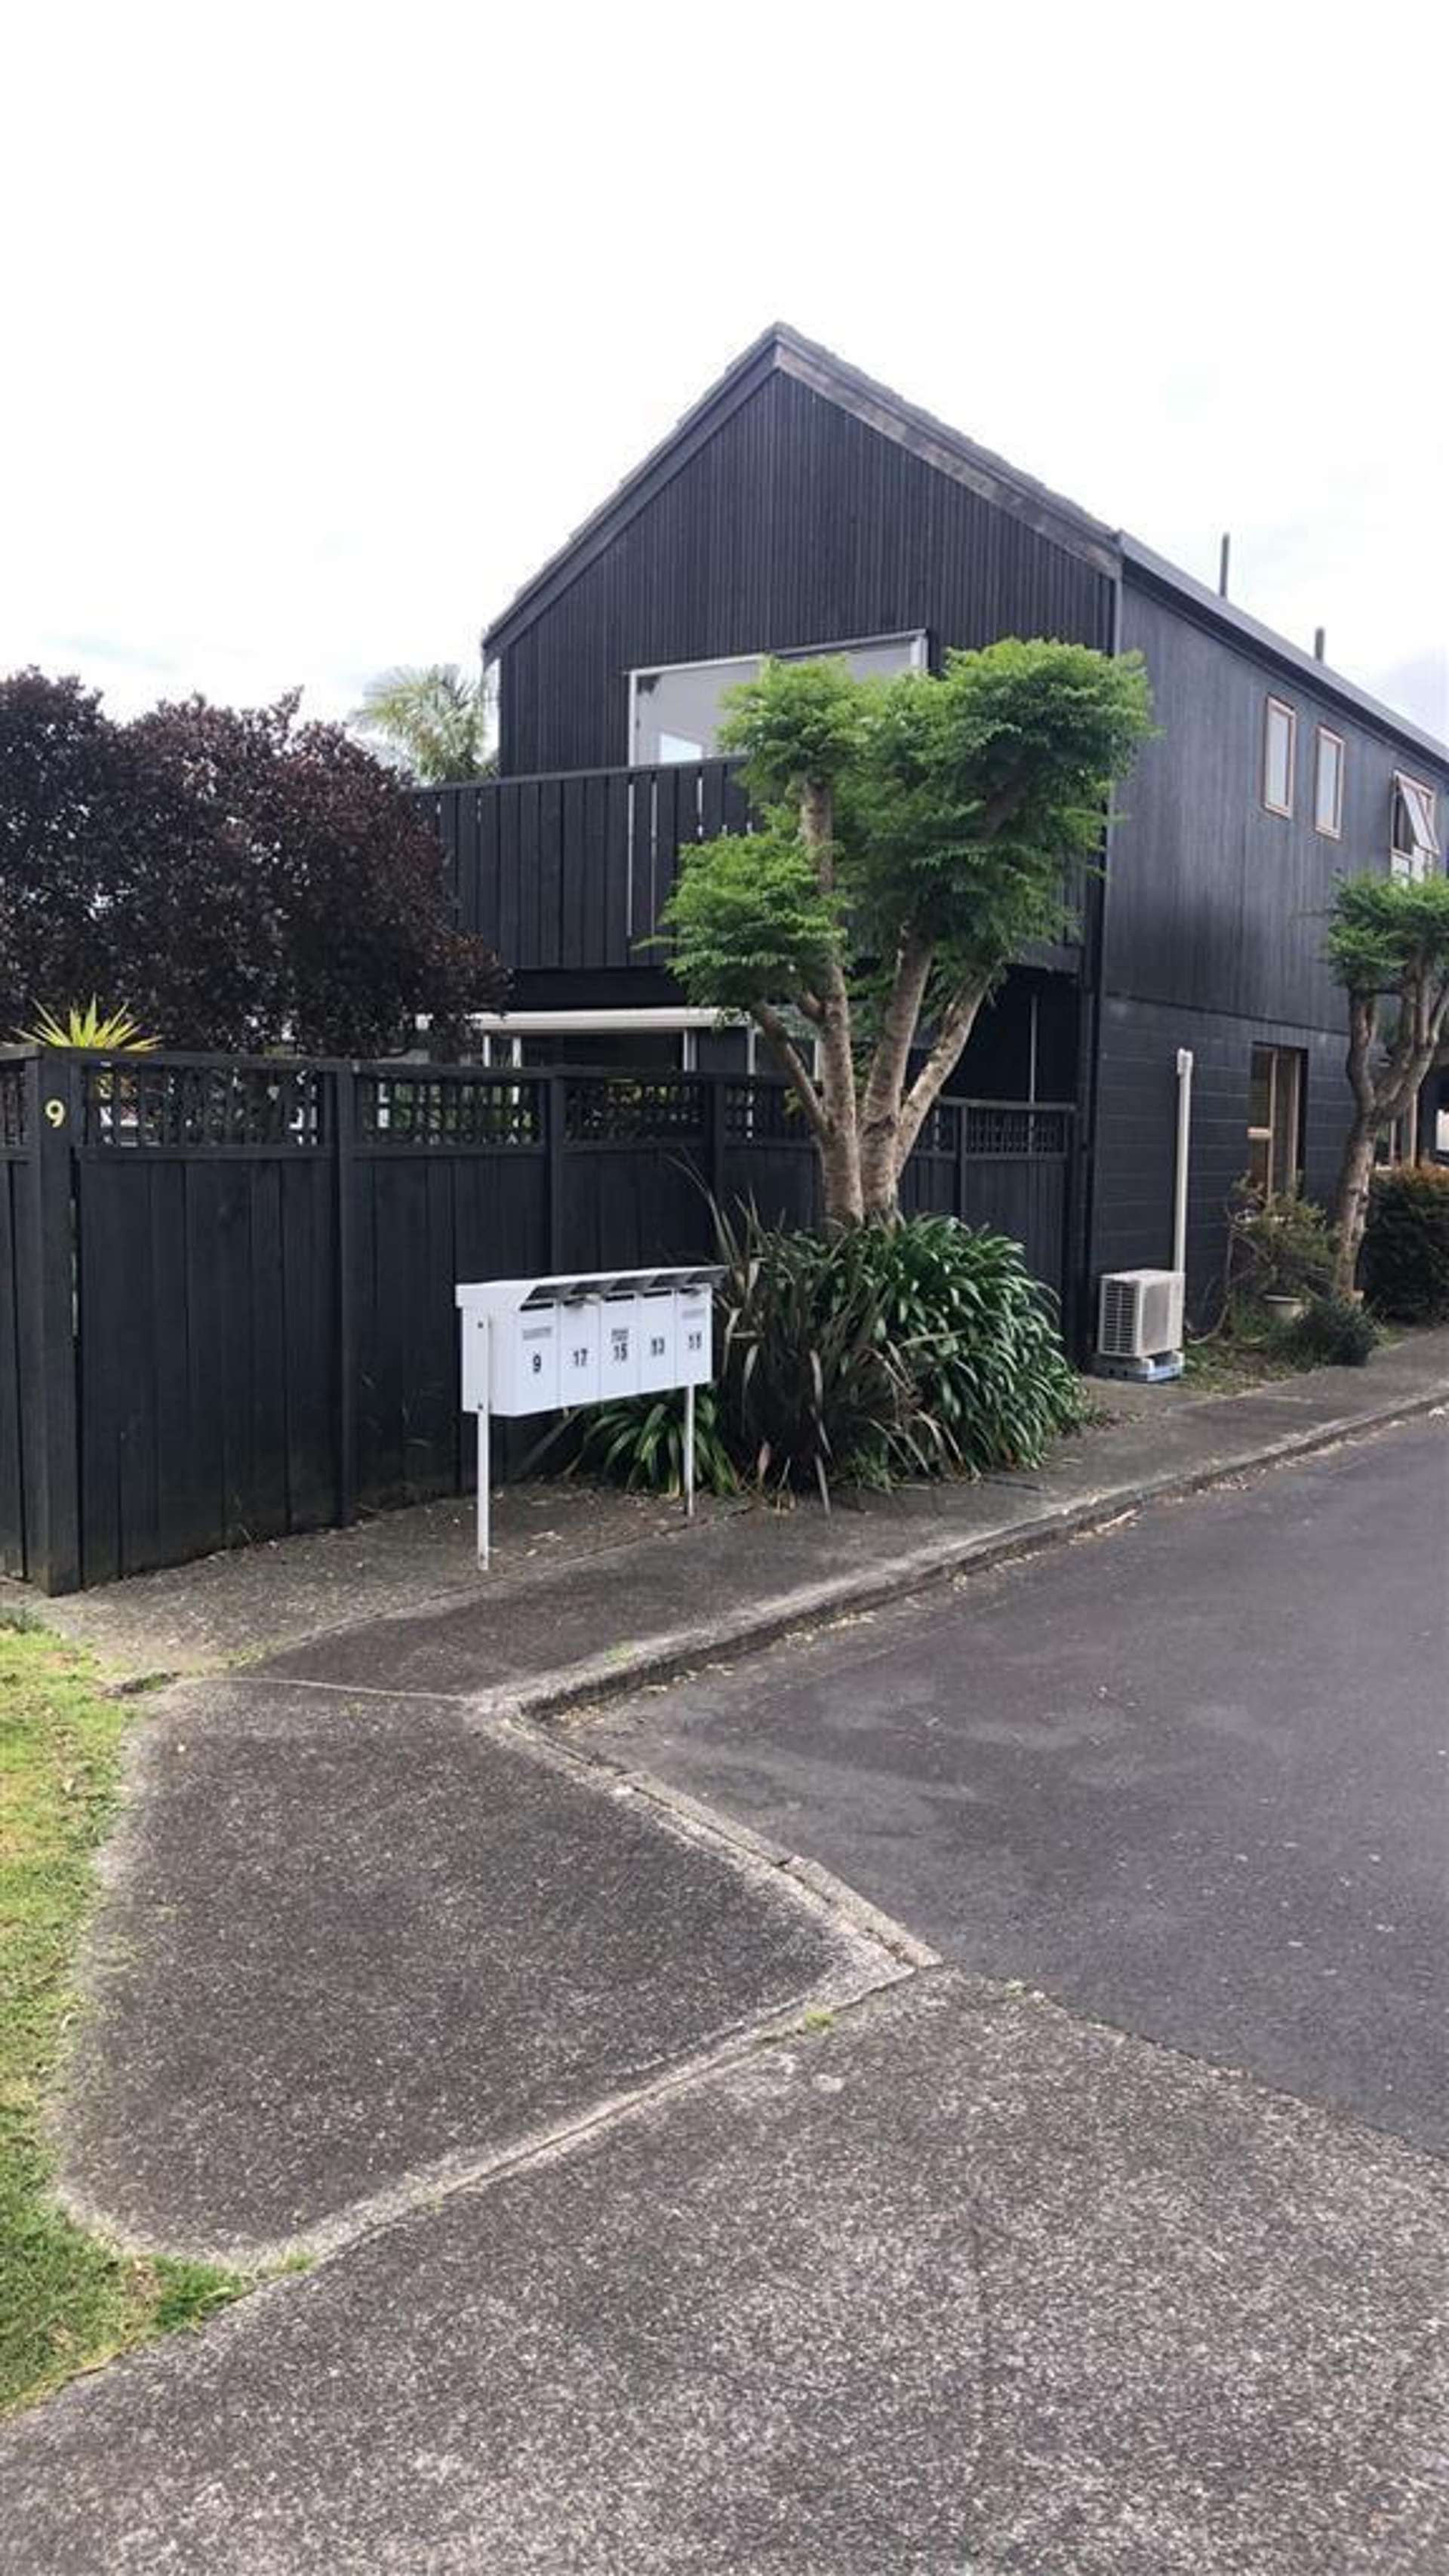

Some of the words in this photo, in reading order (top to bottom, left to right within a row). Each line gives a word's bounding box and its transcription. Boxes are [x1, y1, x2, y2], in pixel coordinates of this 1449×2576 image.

[45, 1099, 65, 1128] 9
[651, 1337, 664, 1356] 13
[688, 1332, 701, 1350] 11
[574, 1348, 588, 1367] 17
[614, 1343, 627, 1360] 15
[533, 1353, 541, 1373] 9
